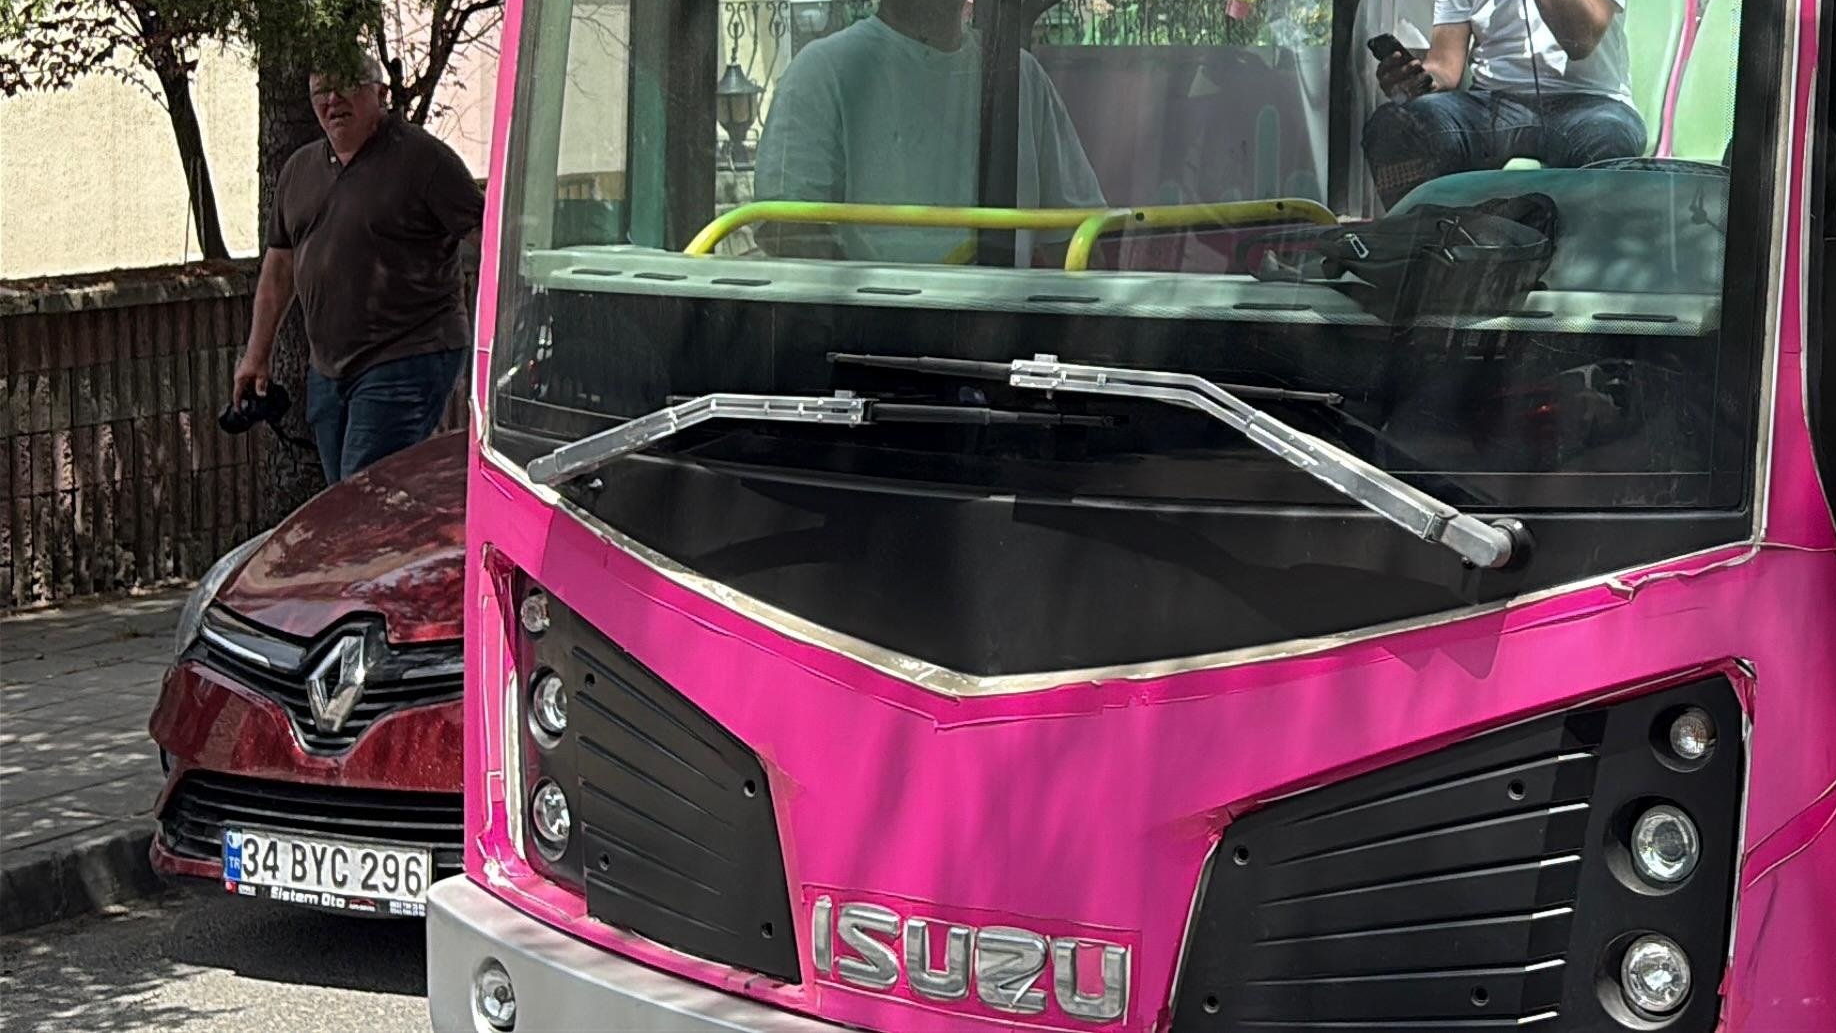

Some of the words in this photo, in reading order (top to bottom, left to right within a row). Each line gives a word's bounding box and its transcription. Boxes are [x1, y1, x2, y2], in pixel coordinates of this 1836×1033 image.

[228, 857, 241, 870] TR
[243, 837, 280, 880] 34
[291, 842, 349, 889] BYC
[360, 851, 422, 898] 296
[812, 895, 1128, 1022] ISUZU
